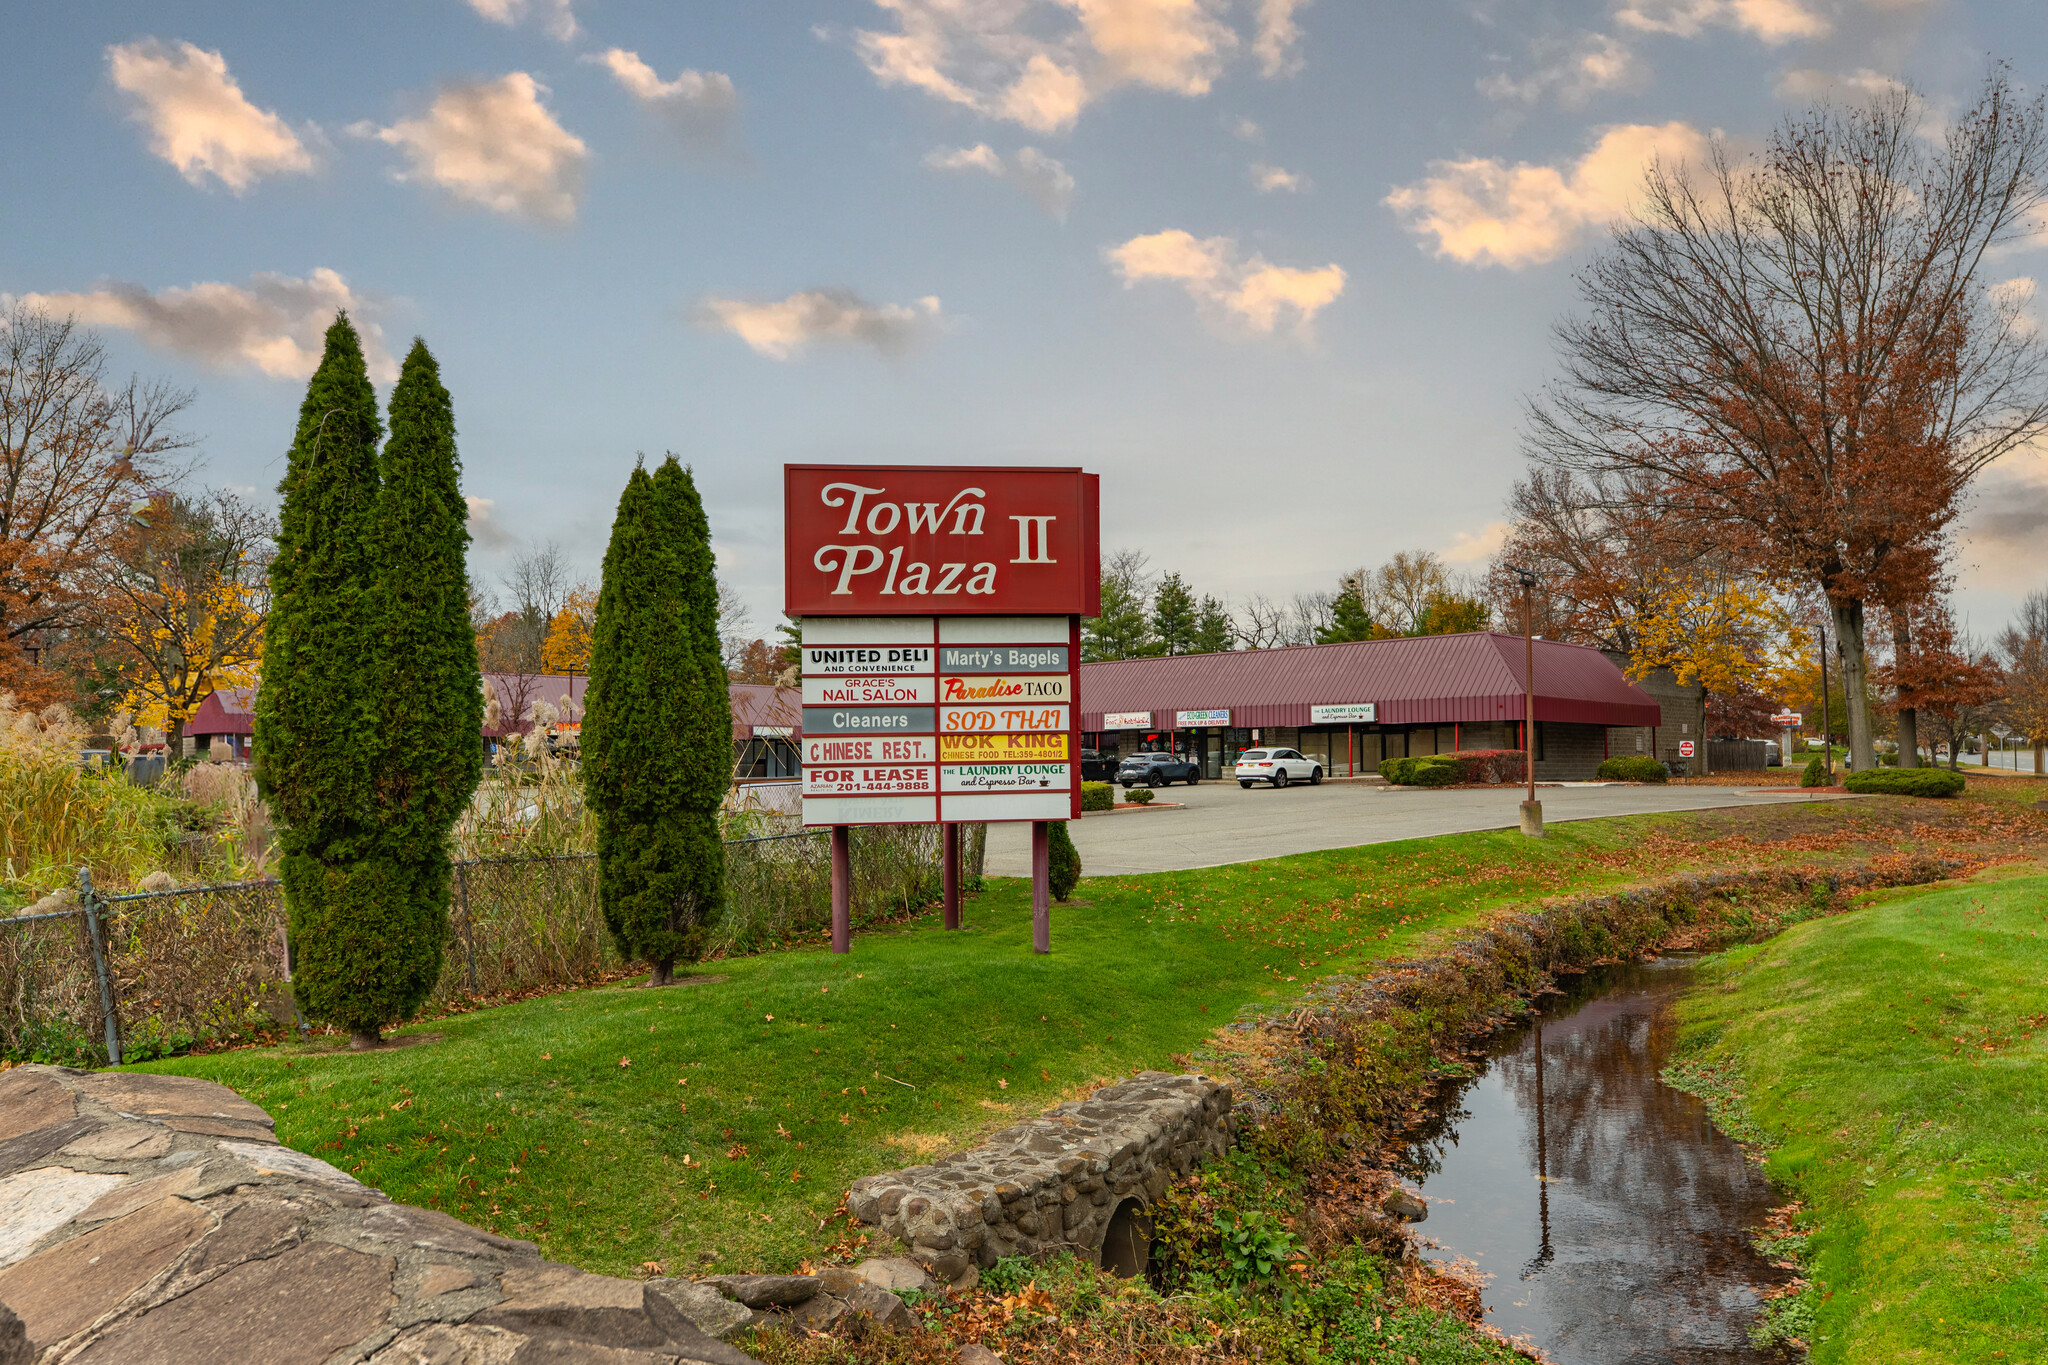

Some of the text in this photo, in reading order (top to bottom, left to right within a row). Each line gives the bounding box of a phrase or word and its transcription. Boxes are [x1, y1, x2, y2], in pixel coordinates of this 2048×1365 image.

[821, 482, 986, 535] Town
[1009, 515, 1057, 564] II
[813, 544, 997, 595] Plaza
[811, 649, 928, 663] UNITED DELI
[946, 650, 1060, 668] Marty's Bagels
[845, 679, 895, 687] GRACE'S
[944, 677, 1062, 701] Paradise TACO
[823, 689, 917, 701] NAIL SALON
[833, 712, 908, 728] Cleaners
[946, 710, 1061, 730] SOD THAI
[1208, 710, 1228, 719] CLEANERS
[942, 734, 1062, 749] WOK KING
[810, 741, 926, 762] CHINESE REST.
[942, 750, 1063, 759] CHINESE FOOD TEL:359-4801/2
[810, 769, 928, 782] FOR LEASE
[960, 766, 1013, 775] LAUNDRY
[1017, 765, 1065, 774] LOUNGE
[837, 782, 929, 791] 201-444-9888
[961, 776, 1036, 790] and Espresso Bar
